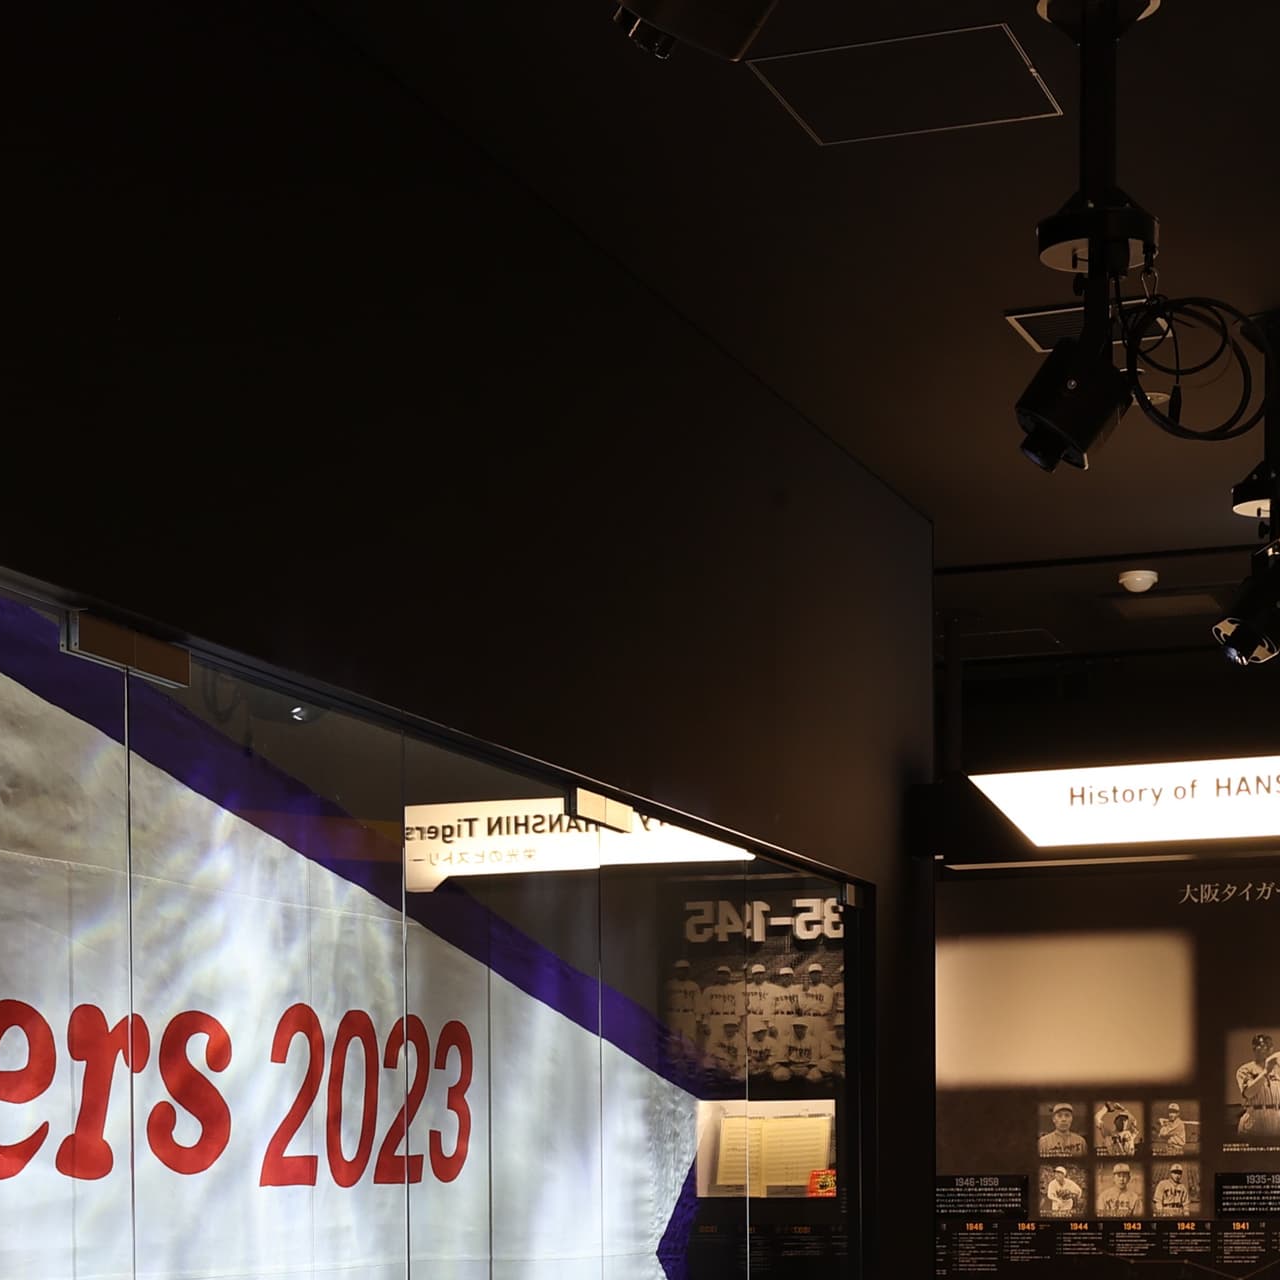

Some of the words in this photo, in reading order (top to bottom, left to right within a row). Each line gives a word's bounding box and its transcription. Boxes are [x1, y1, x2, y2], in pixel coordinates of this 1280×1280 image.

[1071, 785, 1163, 806] History
[1174, 780, 1198, 800] of
[259, 1002, 474, 1189] 2023
